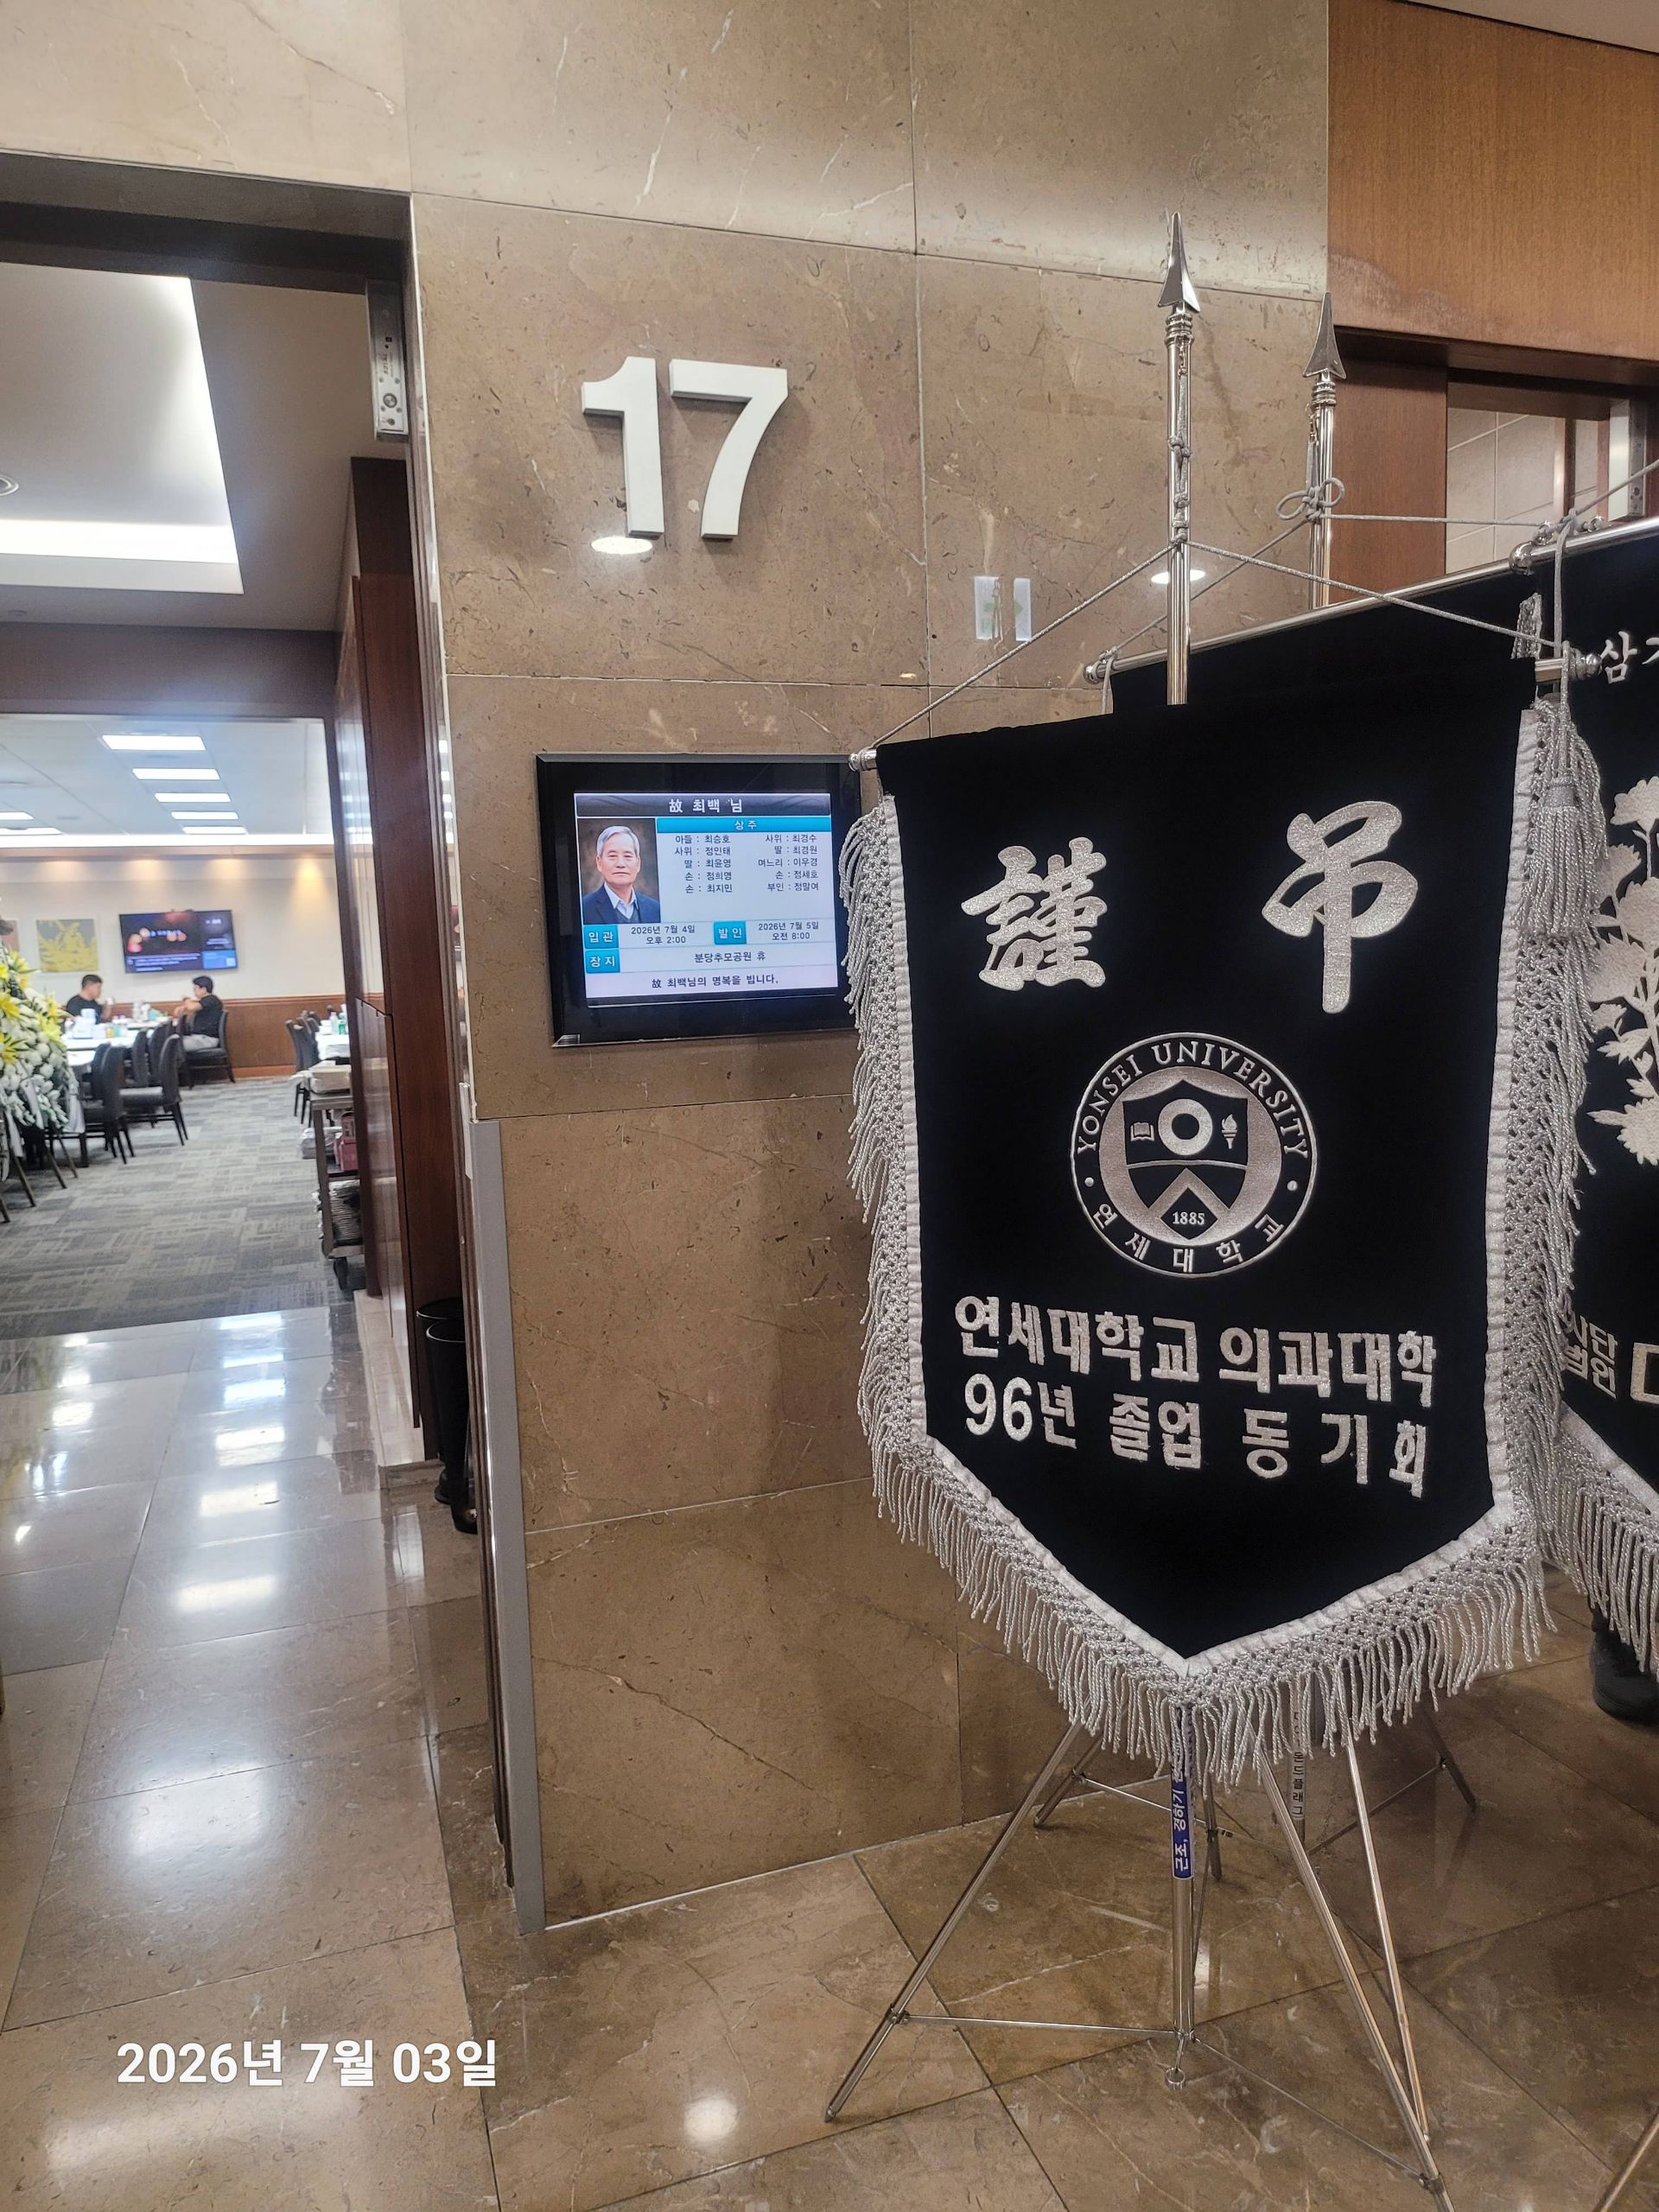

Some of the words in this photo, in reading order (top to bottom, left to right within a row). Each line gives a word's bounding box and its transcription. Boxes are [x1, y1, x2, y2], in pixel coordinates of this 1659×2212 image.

[581, 355, 788, 539] 17
[669, 798, 683, 813] 故
[693, 798, 721, 813] 최백
[730, 798, 742, 813] 님
[675, 836, 692, 844] 아들
[704, 835, 731, 843] 최승호
[792, 834, 817, 842] 최경수
[675, 847, 692, 855] 사위
[705, 847, 731, 855] 정인태
[774, 846, 782, 855] 딸
[793, 845, 817, 855] 최경원
[684, 860, 692, 868] 딸
[759, 859, 783, 868] 며느리
[793, 858, 818, 867] 이우경
[685, 873, 693, 881] 손
[793, 870, 818, 879] 정세호
[707, 884, 733, 893] 최지민
[768, 883, 784, 892] 부인
[631, 925, 660, 935] 2026년
[665, 925, 677, 934] 7월
[683, 925, 696, 933] 4일
[759, 922, 786, 931] 2026년
[805, 921, 819, 930] 5일
[646, 936, 664, 945] 오후
[667, 935, 686, 944] 2:00
[772, 932, 788, 941] 오전
[791, 931, 810, 940] 8:00
[695, 951, 752, 963] 분당추모공원
[652, 978, 662, 988] 故
[667, 976, 707, 988] 최백님의
[712, 975, 741, 986] 명복을
[747, 973, 779, 985] 빕니다.
[1077, 1054, 1143, 1154] YONSEI
[1151, 1040, 1308, 1158] UNIVERSITY
[1172, 1211, 1205, 1225] 1885
[955, 1296, 1199, 1382] 연세대학교
[1218, 1326, 1436, 1408] 의과대학
[964, 1373, 1077, 1449] 96년
[1109, 1390, 1202, 1470] 졸업
[1172, 1788, 1188, 1833] 경하기
